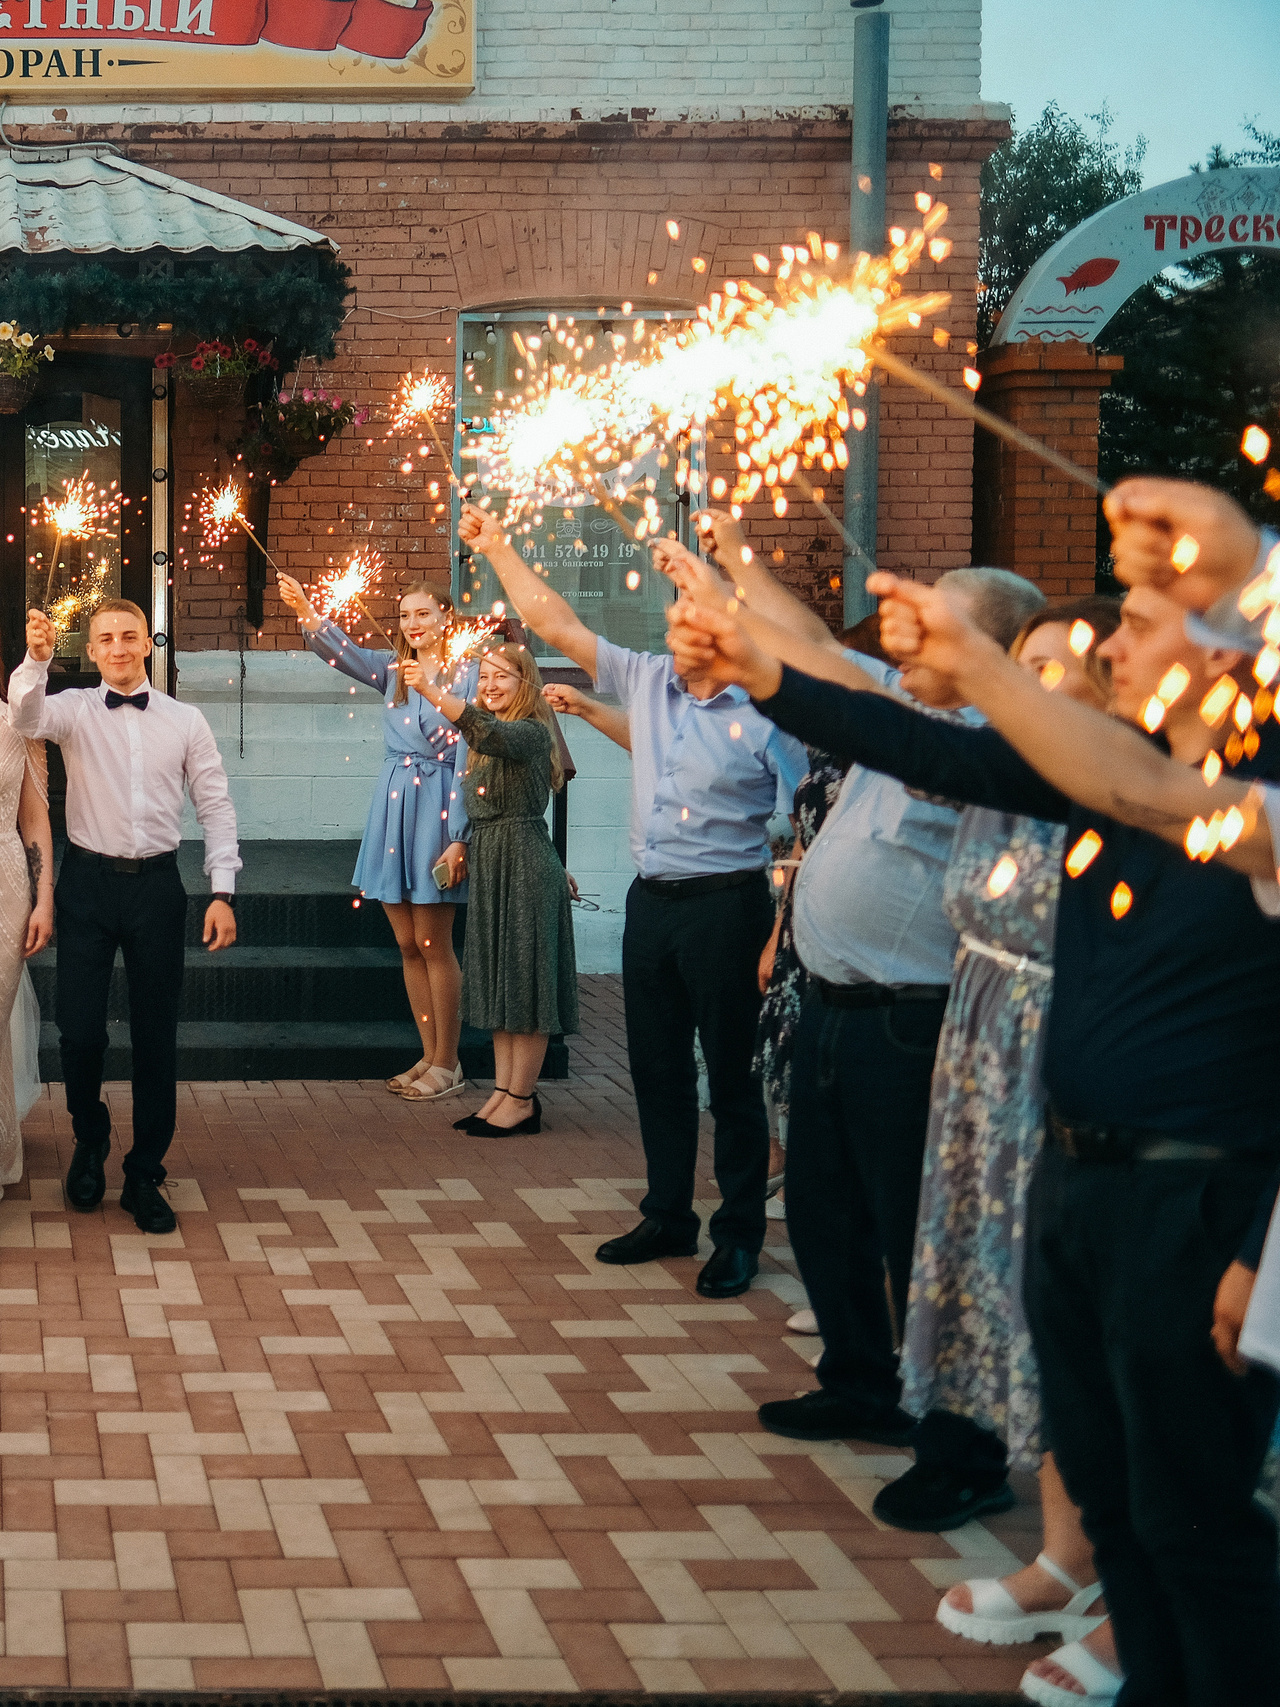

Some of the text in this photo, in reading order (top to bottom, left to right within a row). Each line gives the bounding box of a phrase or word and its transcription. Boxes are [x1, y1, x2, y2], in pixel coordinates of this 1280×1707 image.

[522, 544, 546, 558] 911
[592, 544, 609, 558] 19
[618, 543, 635, 558] 19
[562, 559, 604, 568] банкетов
[562, 590, 604, 598] столиков
